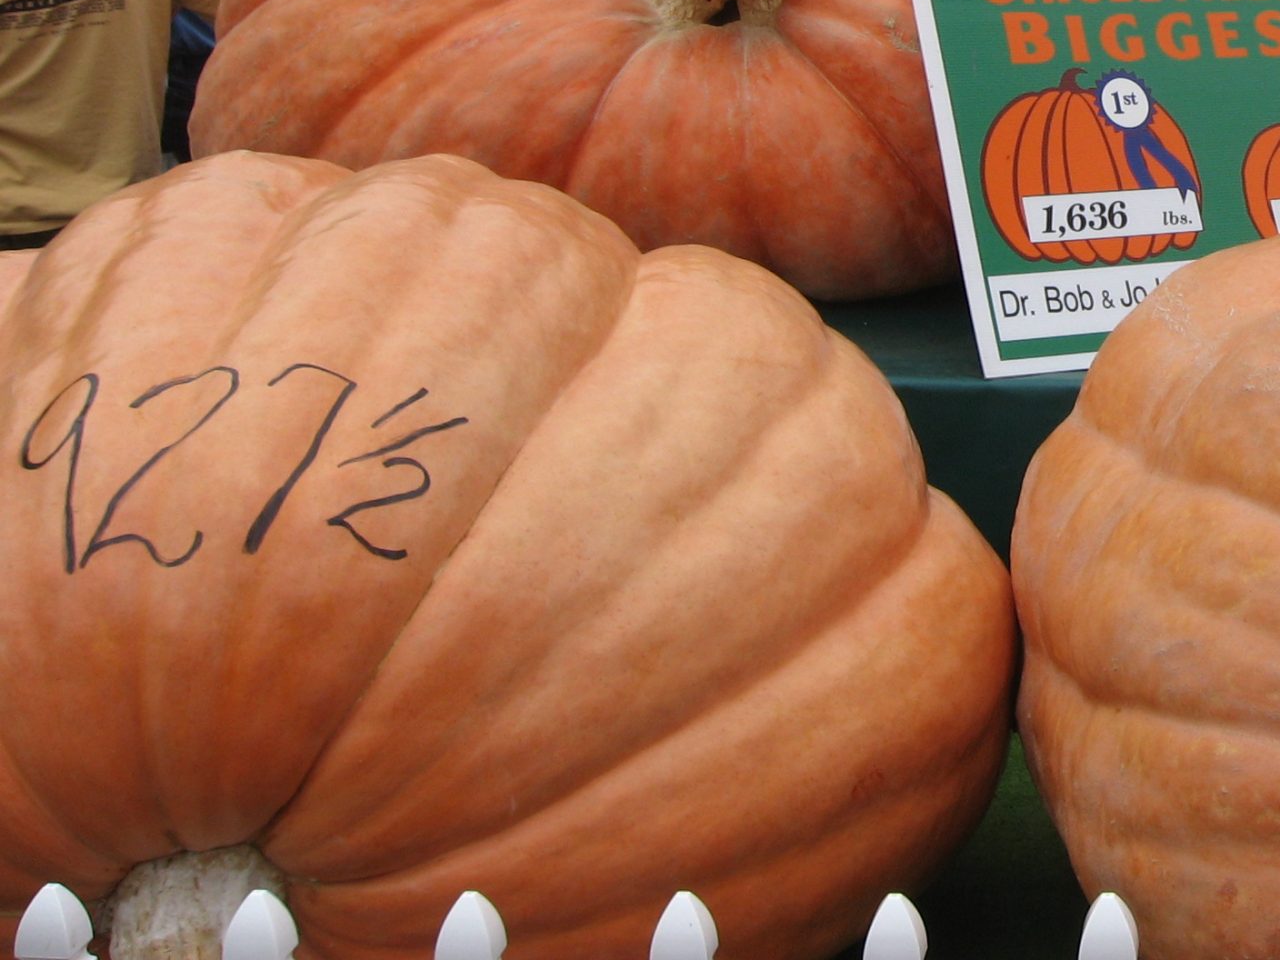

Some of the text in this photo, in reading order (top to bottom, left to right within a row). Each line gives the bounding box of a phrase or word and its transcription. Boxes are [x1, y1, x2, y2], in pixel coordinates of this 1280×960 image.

[1112, 90, 1140, 115] 1st
[1041, 199, 1194, 236] 1,636 lbs.
[998, 289, 1036, 318] Dr.
[1043, 284, 1095, 314] Bob
[1102, 289, 1115, 310] &
